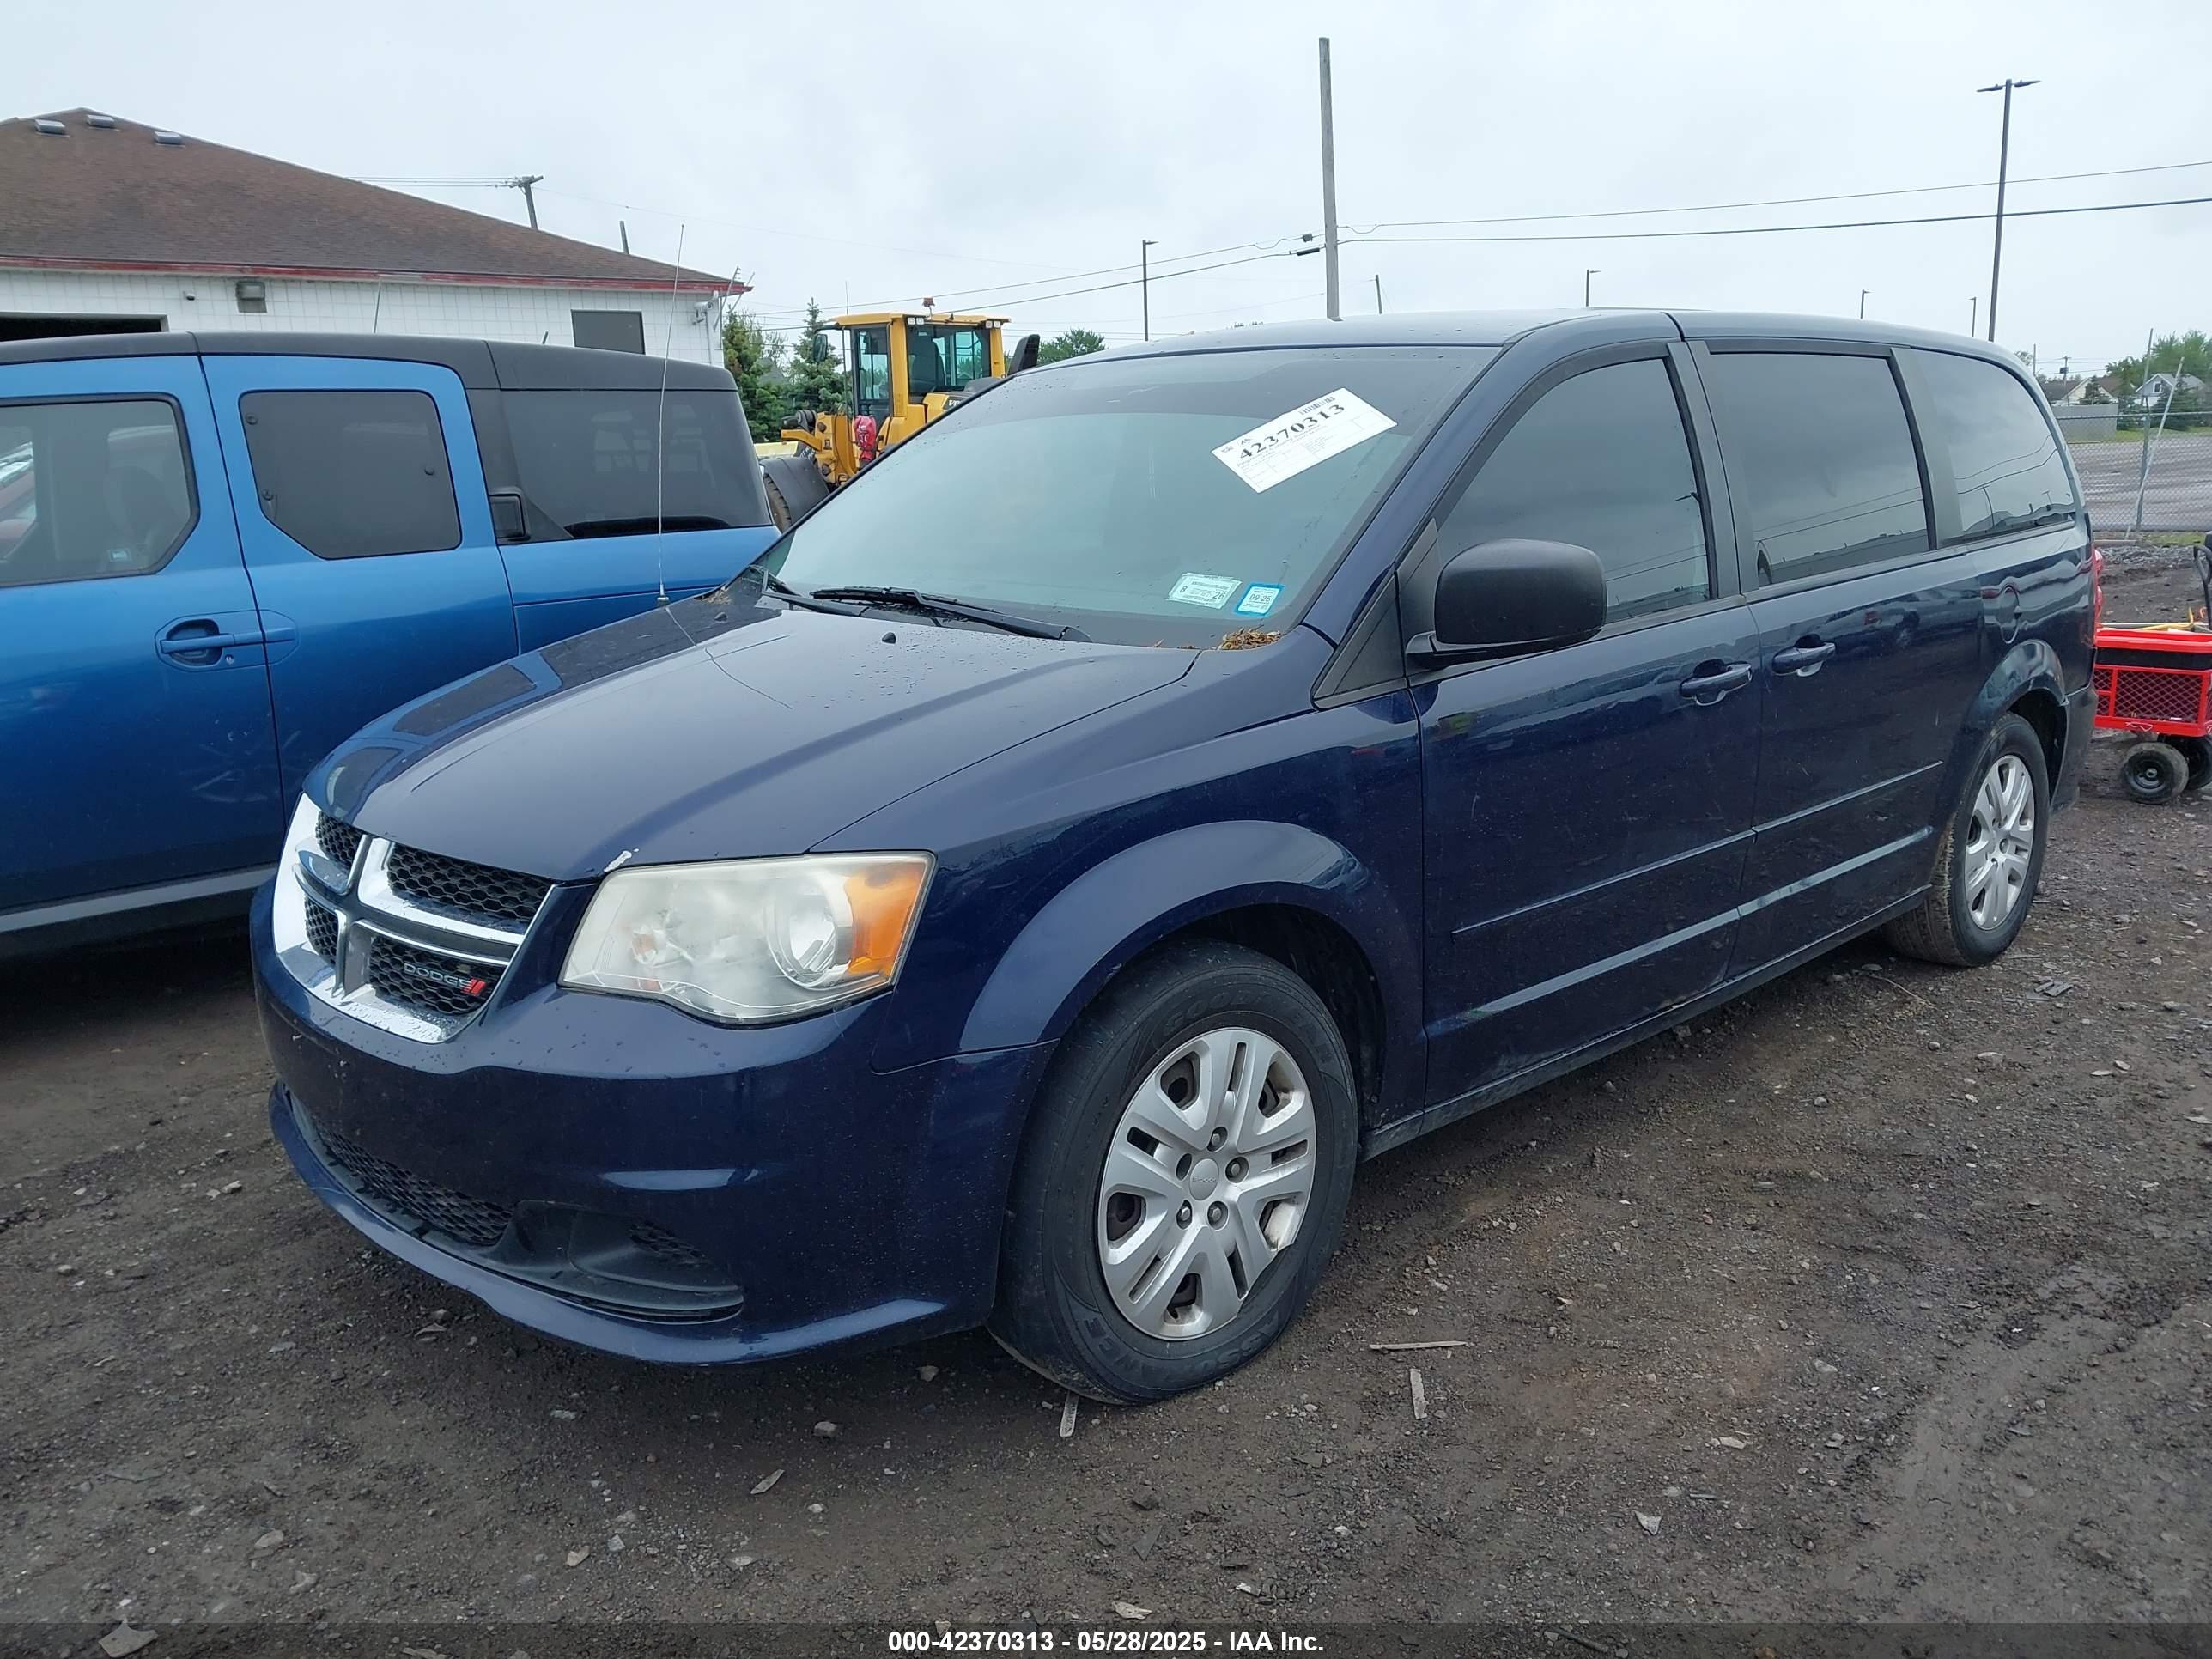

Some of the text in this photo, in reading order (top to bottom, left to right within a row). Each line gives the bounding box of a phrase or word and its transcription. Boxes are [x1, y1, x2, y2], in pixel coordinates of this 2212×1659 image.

[1239, 404, 1346, 459] 42370313
[1212, 591, 1225, 600] 26
[403, 962, 473, 989] DODGE
